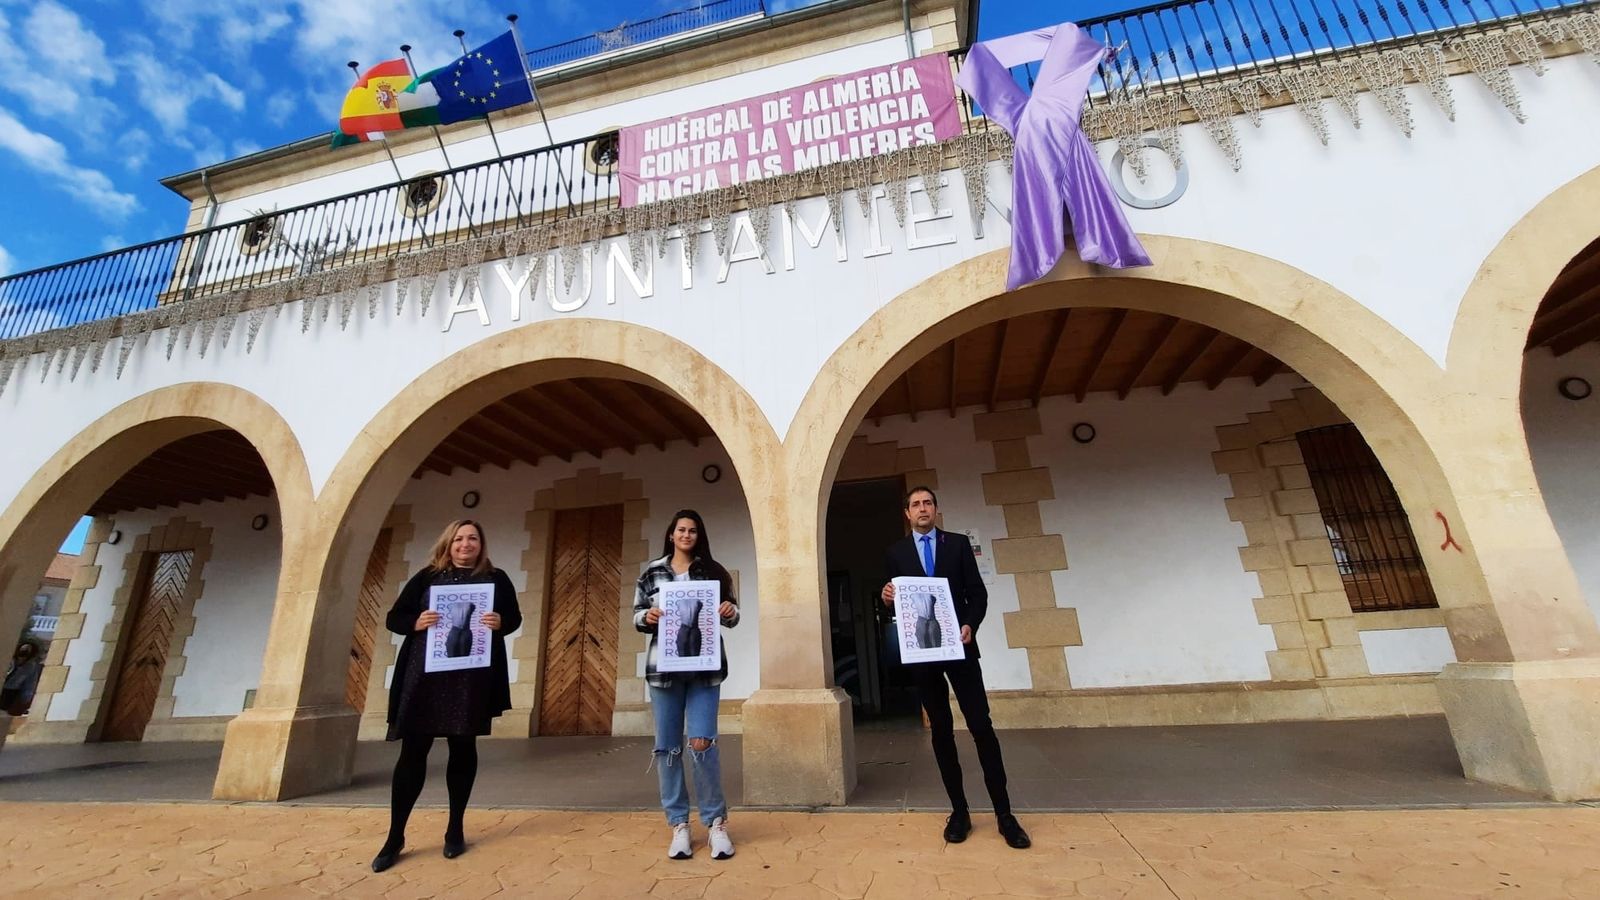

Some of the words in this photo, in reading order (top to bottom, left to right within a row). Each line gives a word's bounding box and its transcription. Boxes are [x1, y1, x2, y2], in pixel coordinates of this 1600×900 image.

[644, 105, 753, 152] HUÉRCAL
[761, 92, 793, 125] DE
[802, 64, 921, 115] ALMERÍA
[639, 136, 739, 179] CONTRA
[748, 127, 779, 154] LA
[786, 94, 931, 146] VIOLENCIA
[637, 168, 721, 205] HACIA
[436, 592, 488, 602] ROCES
[665, 589, 714, 599] ROCES
[899, 585, 945, 593] ROCES
